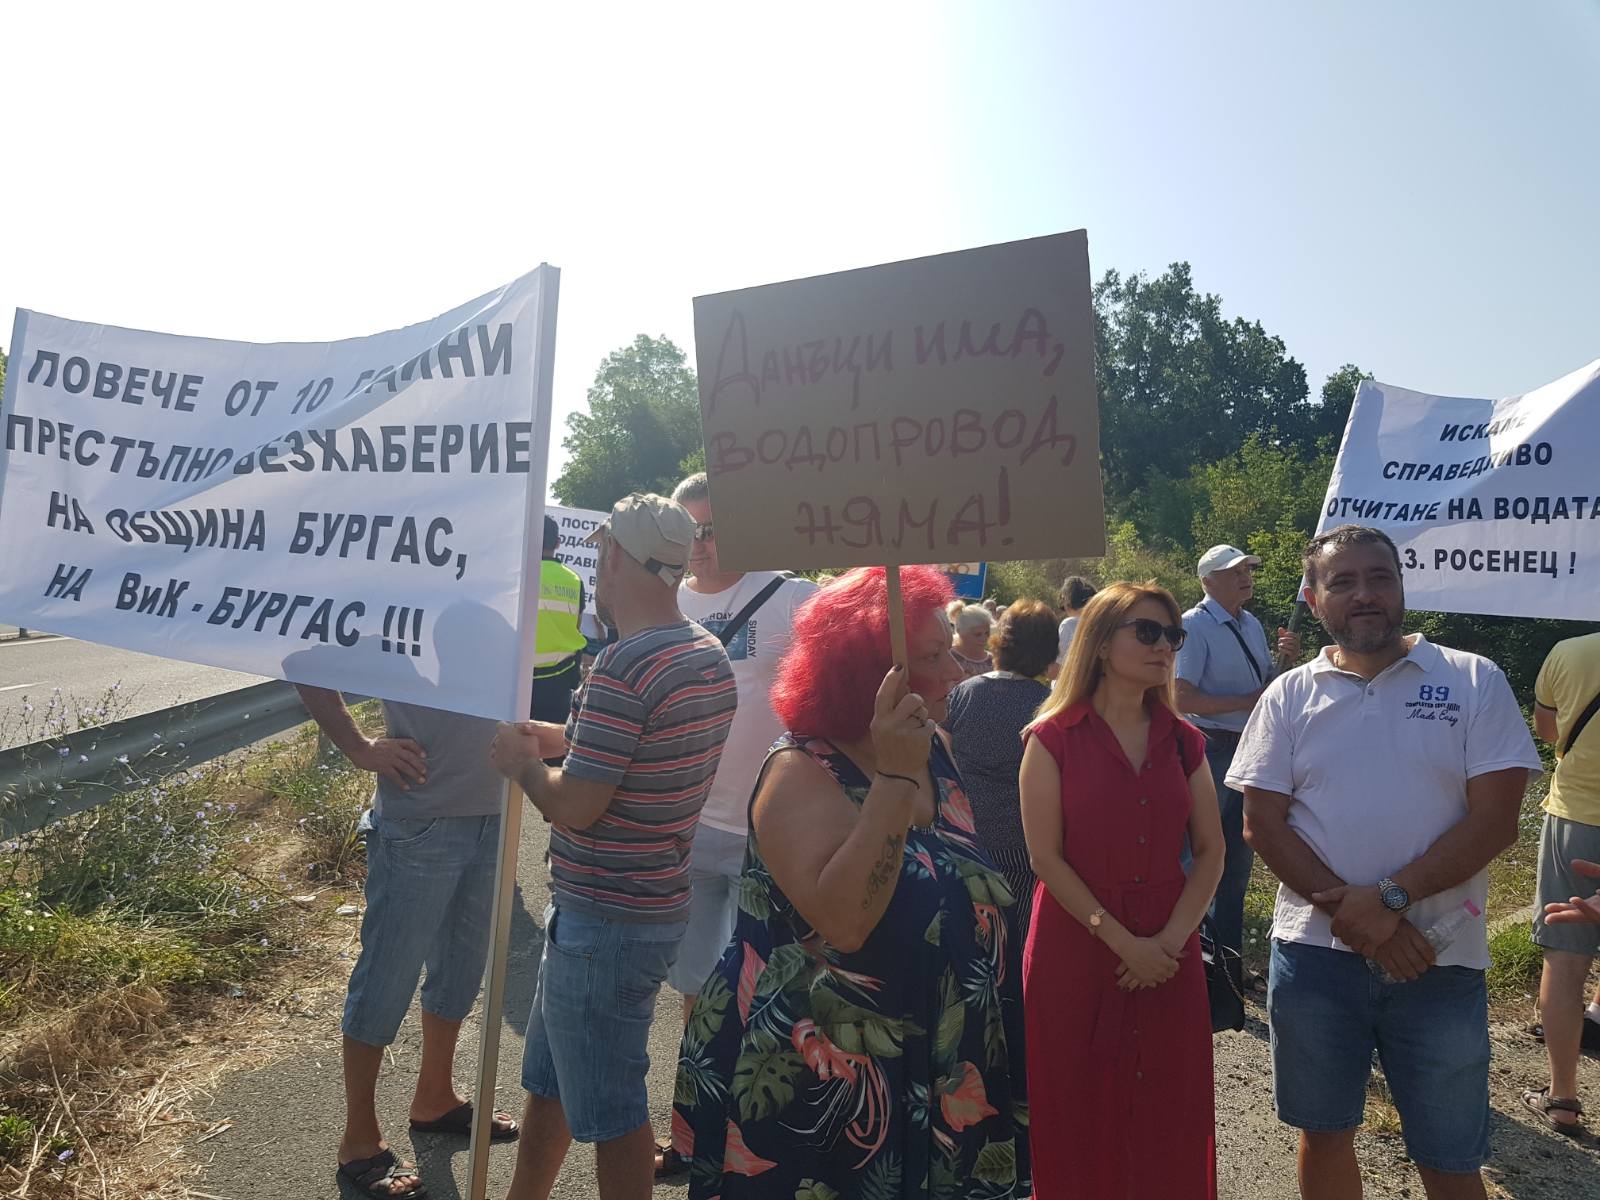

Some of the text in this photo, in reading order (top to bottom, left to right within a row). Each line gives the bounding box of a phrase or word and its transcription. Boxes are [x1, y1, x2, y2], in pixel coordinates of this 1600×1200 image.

[27, 350, 204, 412] ПОВЕЧЕ
[224, 380, 278, 417] ОТ
[290, 377, 334, 415] 10
[6, 414, 234, 482] ПРЕСТЪПНО
[708, 395, 1077, 475] ВОДОПРОВОД
[1439, 414, 1528, 442] ИСКАМЕ
[1382, 442, 1553, 482] СПРАВЕДЛИВО
[794, 465, 1015, 549] НЯМА!
[1326, 497, 1441, 522] ОТЧИТАНЕ
[1448, 497, 1482, 519] НА
[47, 491, 467, 580] НА ОБЩИНА БУРГАС,
[1434, 549, 1557, 578] РОСЕНЕЦ
[44, 563, 93, 602] НА
[115, 572, 190, 618] ВиК
[206, 586, 365, 648] БУРГАС
[381, 606, 425, 656] !!!
[748, 620, 757, 657] SUNDAY
[1419, 685, 1449, 701] 89
[1406, 709, 1458, 727] Made Easy
